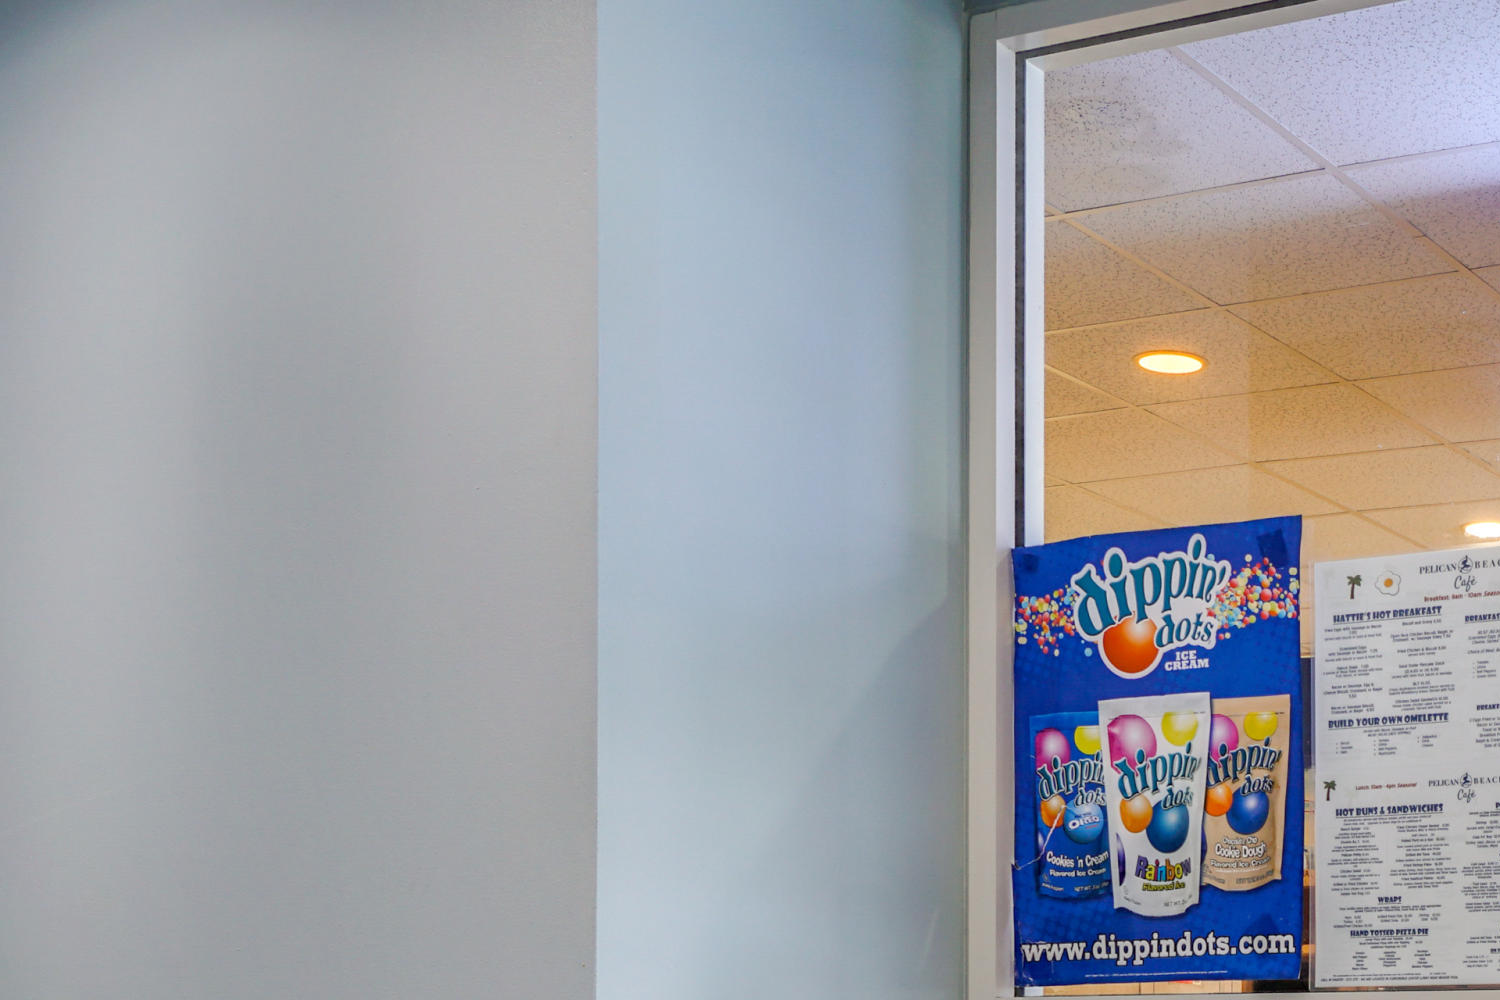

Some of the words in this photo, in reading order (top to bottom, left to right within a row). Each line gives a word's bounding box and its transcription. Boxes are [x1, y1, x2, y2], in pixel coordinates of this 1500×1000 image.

[1419, 563, 1457, 575] PELICAN
[1333, 611, 1371, 624] HATTIE'S
[1372, 610, 1391, 620] HOT
[1392, 605, 1442, 619] BREAKFAST
[1155, 612, 1214, 648] dots
[1176, 650, 1197, 661] ICE
[1164, 658, 1210, 672] CREAM
[1328, 719, 1354, 729] BUILD
[1356, 717, 1380, 726] YOUR
[1381, 715, 1403, 725] OWN
[1404, 712, 1449, 723] OMELETTE
[1240, 774, 1274, 796] dots
[1428, 778, 1459, 788] PELICAN
[1074, 786, 1106, 807] dots
[1161, 786, 1193, 811] dots
[1335, 808, 1354, 817] HOT
[1356, 807, 1378, 816] BUNS
[1387, 803, 1443, 814] SANDWICHES
[1215, 843, 1241, 858] Cookie
[1046, 851, 1075, 868] Cookies
[1085, 850, 1109, 867] Cream
[1210, 859, 1237, 868] Flavored
[1239, 859, 1249, 868] Ice
[1049, 868, 1075, 878] Flavored
[1076, 869, 1086, 877] Ice
[1135, 855, 1191, 882] Rainbow
[1395, 928, 1416, 936] PIZZA
[1021, 931, 1296, 966] www.dippindots.com
